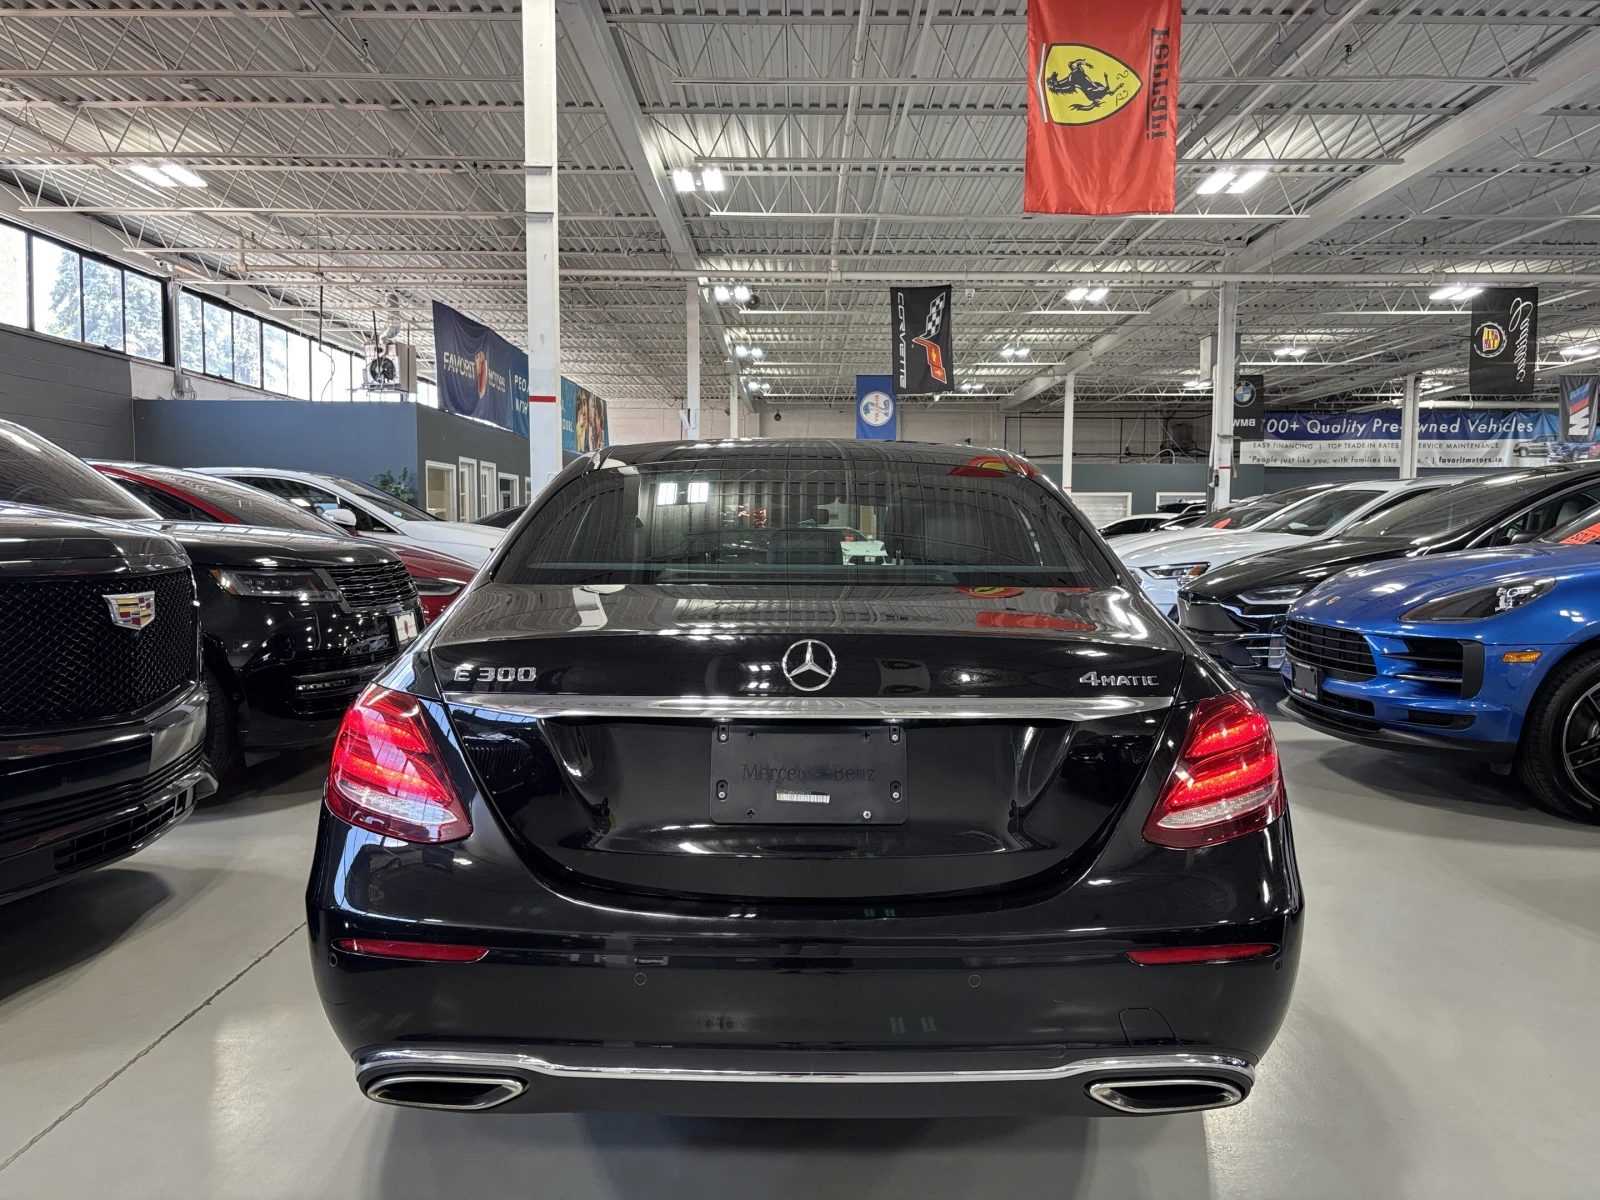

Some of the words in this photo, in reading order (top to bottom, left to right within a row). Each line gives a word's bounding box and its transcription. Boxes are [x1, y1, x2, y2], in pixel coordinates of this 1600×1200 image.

[897, 291, 907, 390] CORVETTE
[443, 351, 476, 380] FAVORIT
[488, 368, 506, 393] MOTORS
[1306, 418, 1367, 437] Quality
[1372, 417, 1460, 434] Pre-wned
[1467, 416, 1533, 433] Vehicles
[1280, 456, 1295, 464] just
[1350, 455, 1381, 463] families
[1383, 455, 1397, 463] like
[453, 667, 472, 682] E
[476, 667, 538, 682] 300
[1079, 670, 1160, 687] 4MATIC
